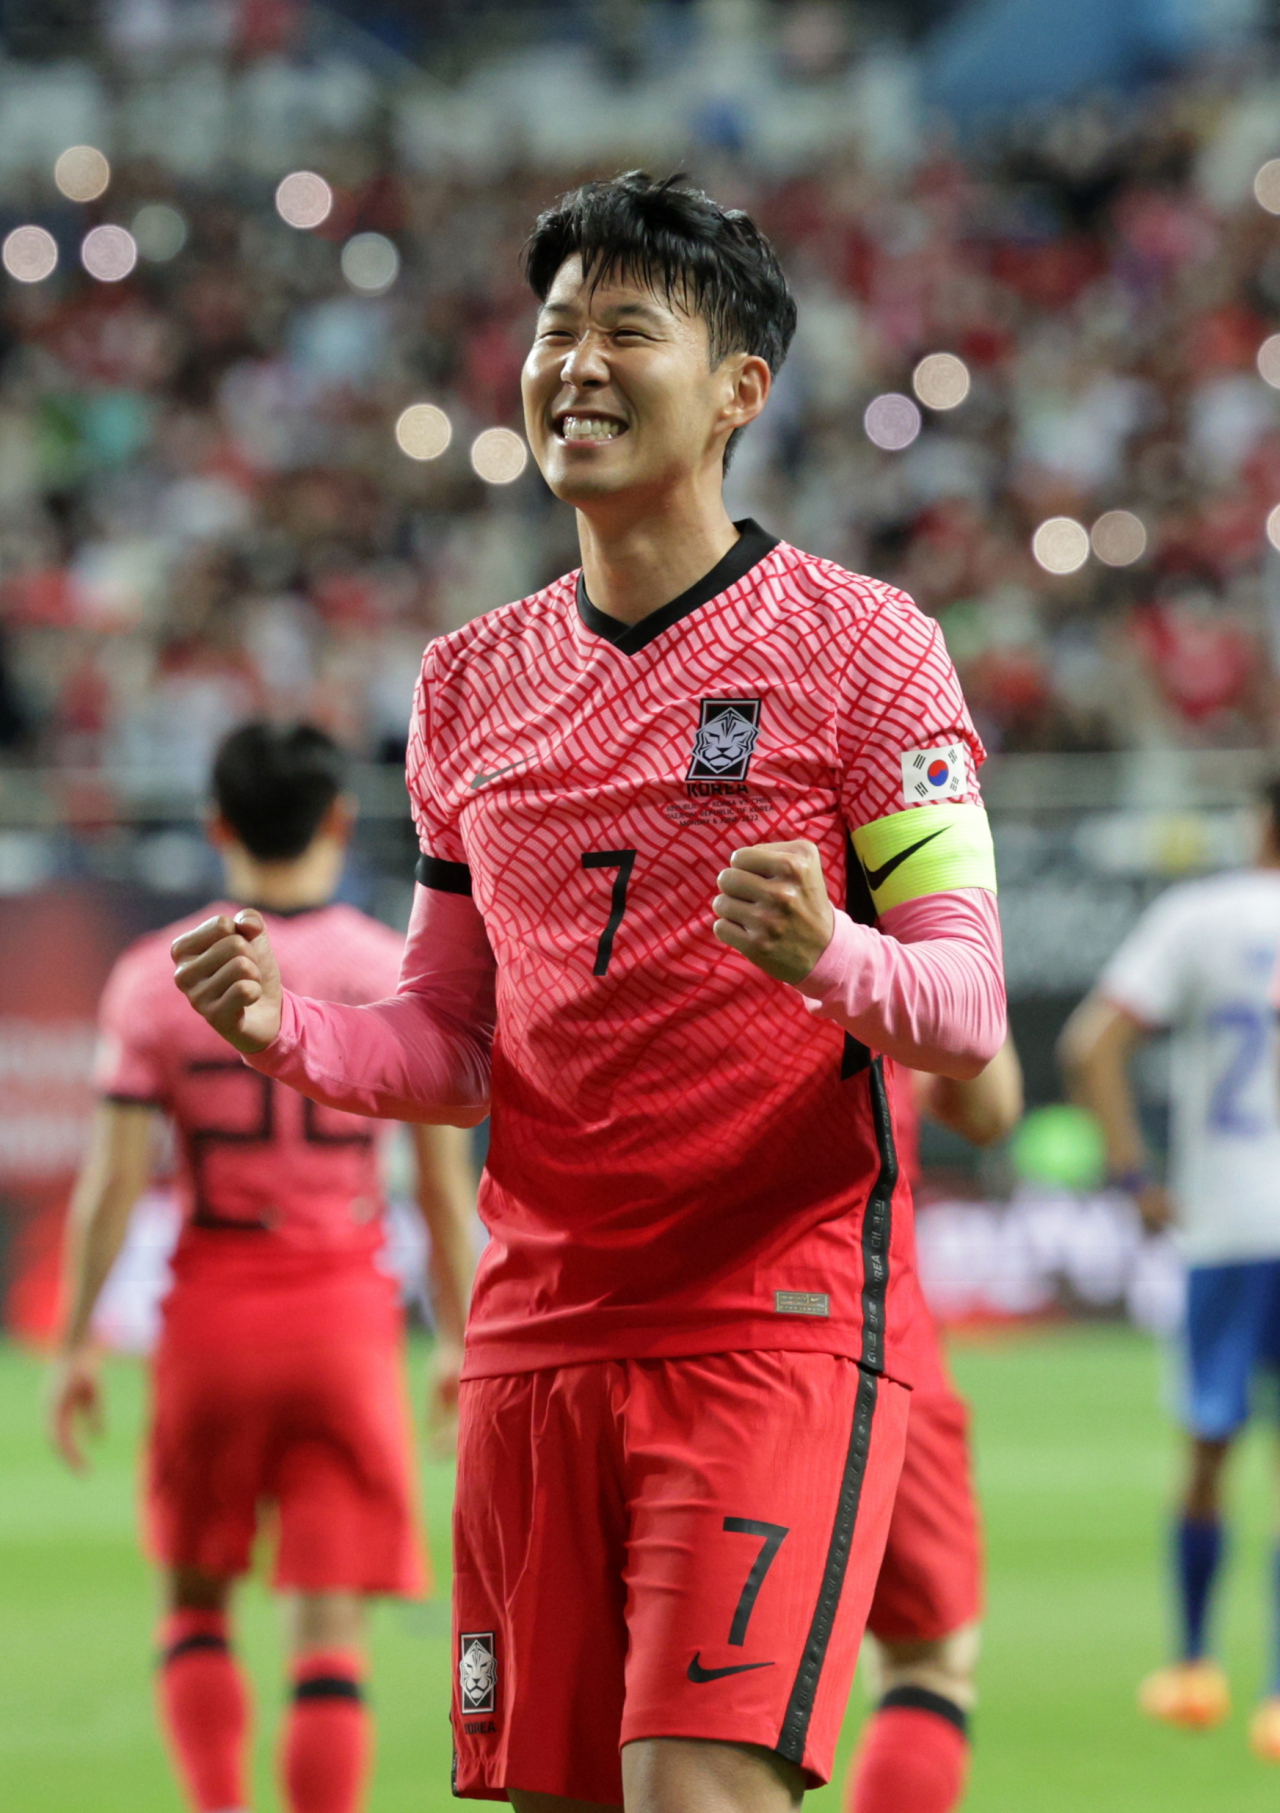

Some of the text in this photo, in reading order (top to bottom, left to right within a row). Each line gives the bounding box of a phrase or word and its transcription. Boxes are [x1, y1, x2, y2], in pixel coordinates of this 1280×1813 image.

[686, 783, 748, 797] KOREA
[581, 849, 637, 976] 7
[723, 1516, 790, 1646] 7
